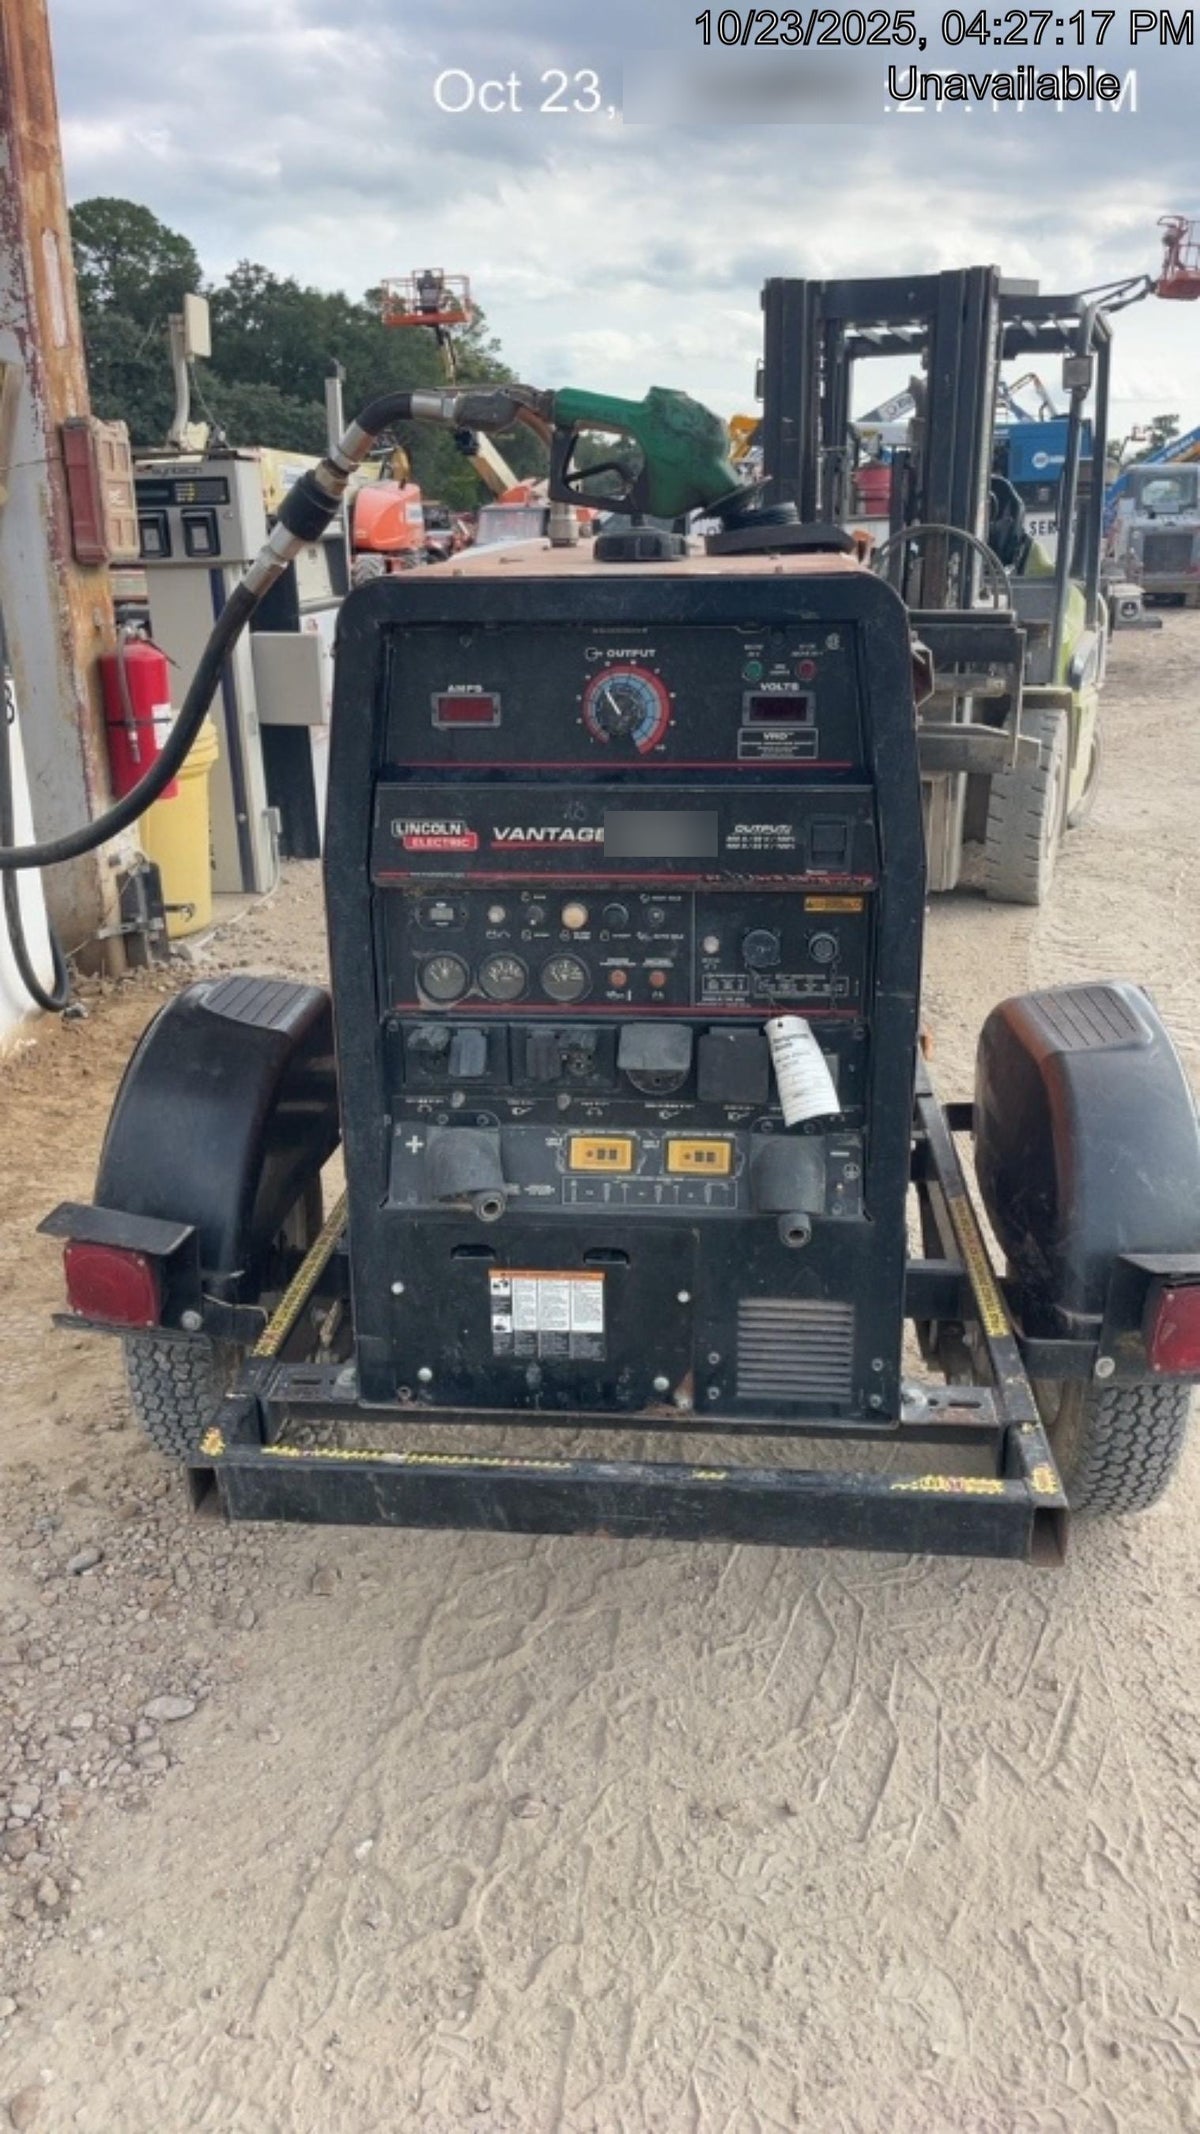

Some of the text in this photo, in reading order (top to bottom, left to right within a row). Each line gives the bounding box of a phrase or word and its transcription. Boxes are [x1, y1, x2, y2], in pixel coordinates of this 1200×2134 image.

[606, 648, 657, 658] OUTPUT
[447, 684, 483, 693] AMPS
[760, 682, 800, 691] VOLTS
[395, 821, 463, 836] LINCOLN
[411, 837, 470, 848] ELECTRIC
